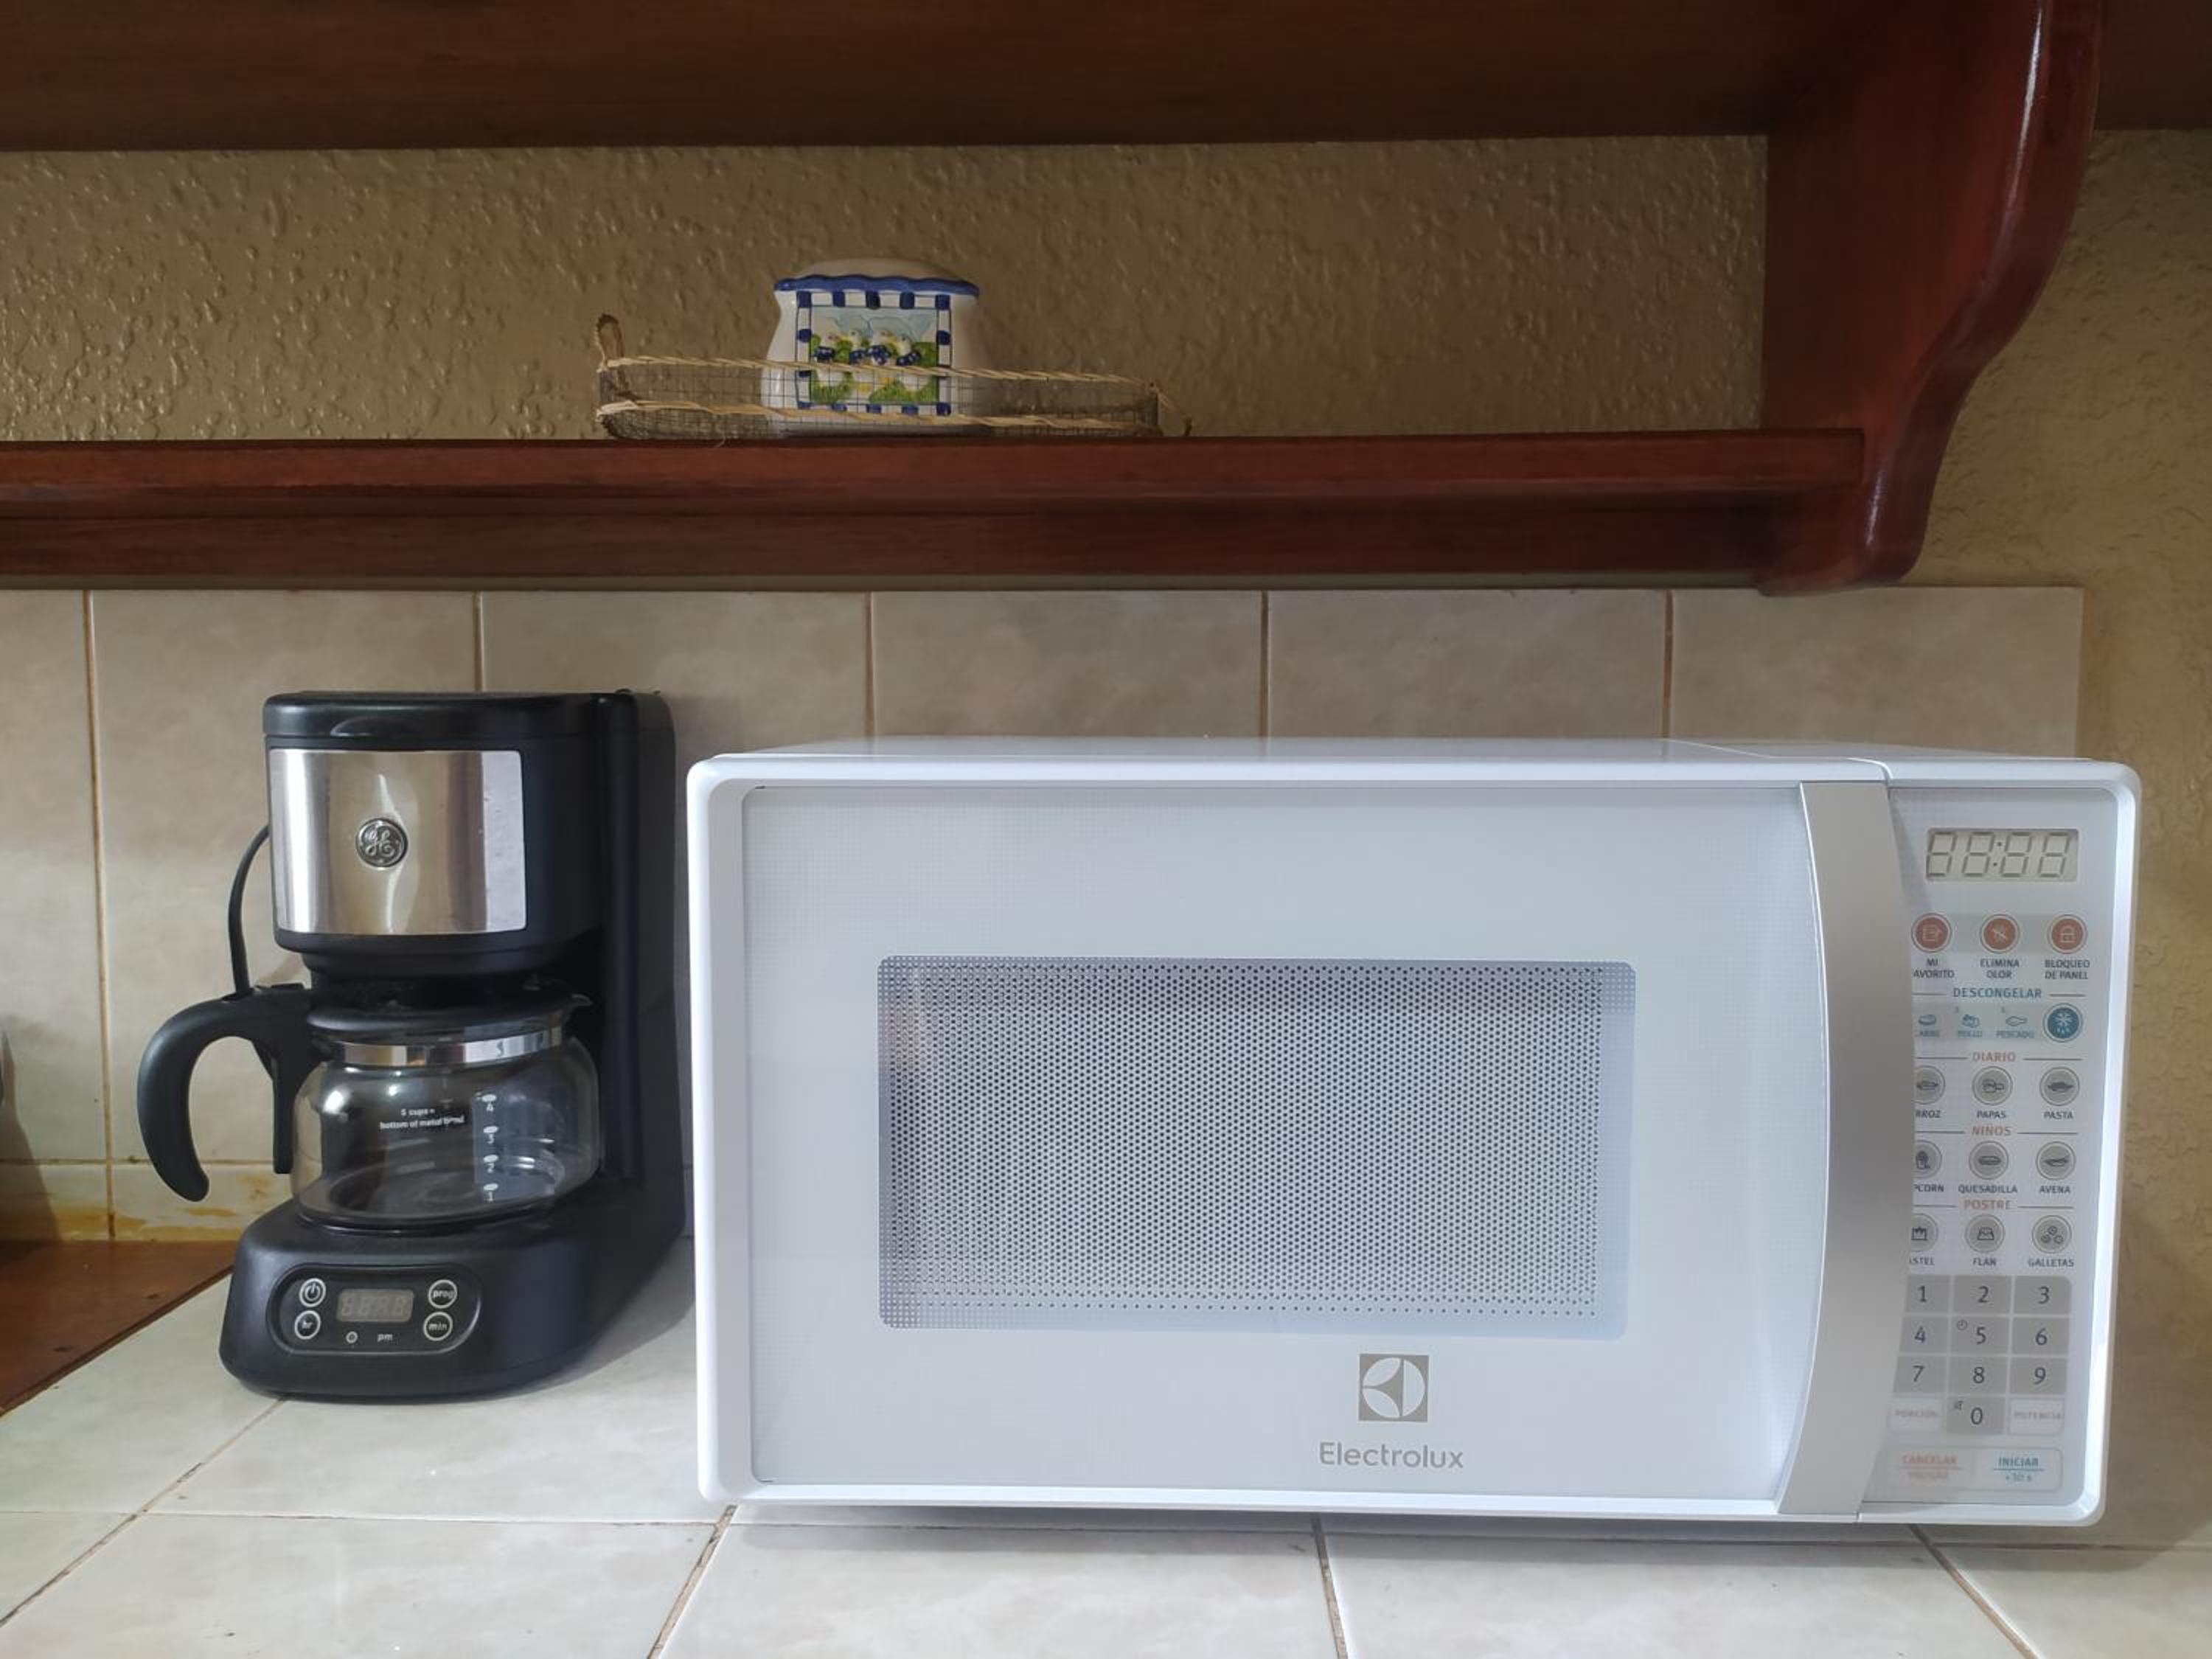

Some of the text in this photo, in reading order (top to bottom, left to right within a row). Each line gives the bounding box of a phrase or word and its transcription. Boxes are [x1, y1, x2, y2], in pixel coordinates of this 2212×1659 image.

[1927, 957, 1938, 966] MI
[1980, 959, 2020, 968] ELIMINA
[2045, 959, 2090, 968] BLOQUEO
[1913, 969, 1955, 978] AVORITO
[1986, 970, 2012, 978] OLOR
[2045, 970, 2089, 979] DE PANEL
[1952, 987, 2042, 998] DESCONGELAR
[1972, 1052, 2016, 1062] DIARIO
[1916, 1109, 1941, 1119] RROZ
[1977, 1110, 2006, 1119] PAPAS
[2044, 1111, 2073, 1119] PASTA
[1958, 1184, 2018, 1194] QUESADILLA
[2039, 1186, 2070, 1194] AVENA
[1964, 1199, 2011, 1210] POSTRE
[1910, 1256, 1935, 1266] STEL
[1973, 1257, 1996, 1266] FLAN
[2028, 1258, 2074, 1267] GALLETAS
[1919, 1285, 1927, 1303] 1
[1978, 1286, 1989, 1304] 2
[2038, 1287, 2050, 1304] 3
[428, 1321, 448, 1330] min
[377, 1332, 393, 1341] pm
[1914, 1326, 1926, 1343] 4
[1976, 1326, 1986, 1345] 5
[2035, 1328, 2048, 1346] 6
[1913, 1365, 1924, 1382] 7
[1972, 1366, 1985, 1384] 8
[2034, 1366, 2046, 1385] 9
[1971, 1407, 1983, 1425] 0
[1319, 1441, 1464, 1469] Electrolux
[1999, 1457, 2038, 1467] INICIAR
